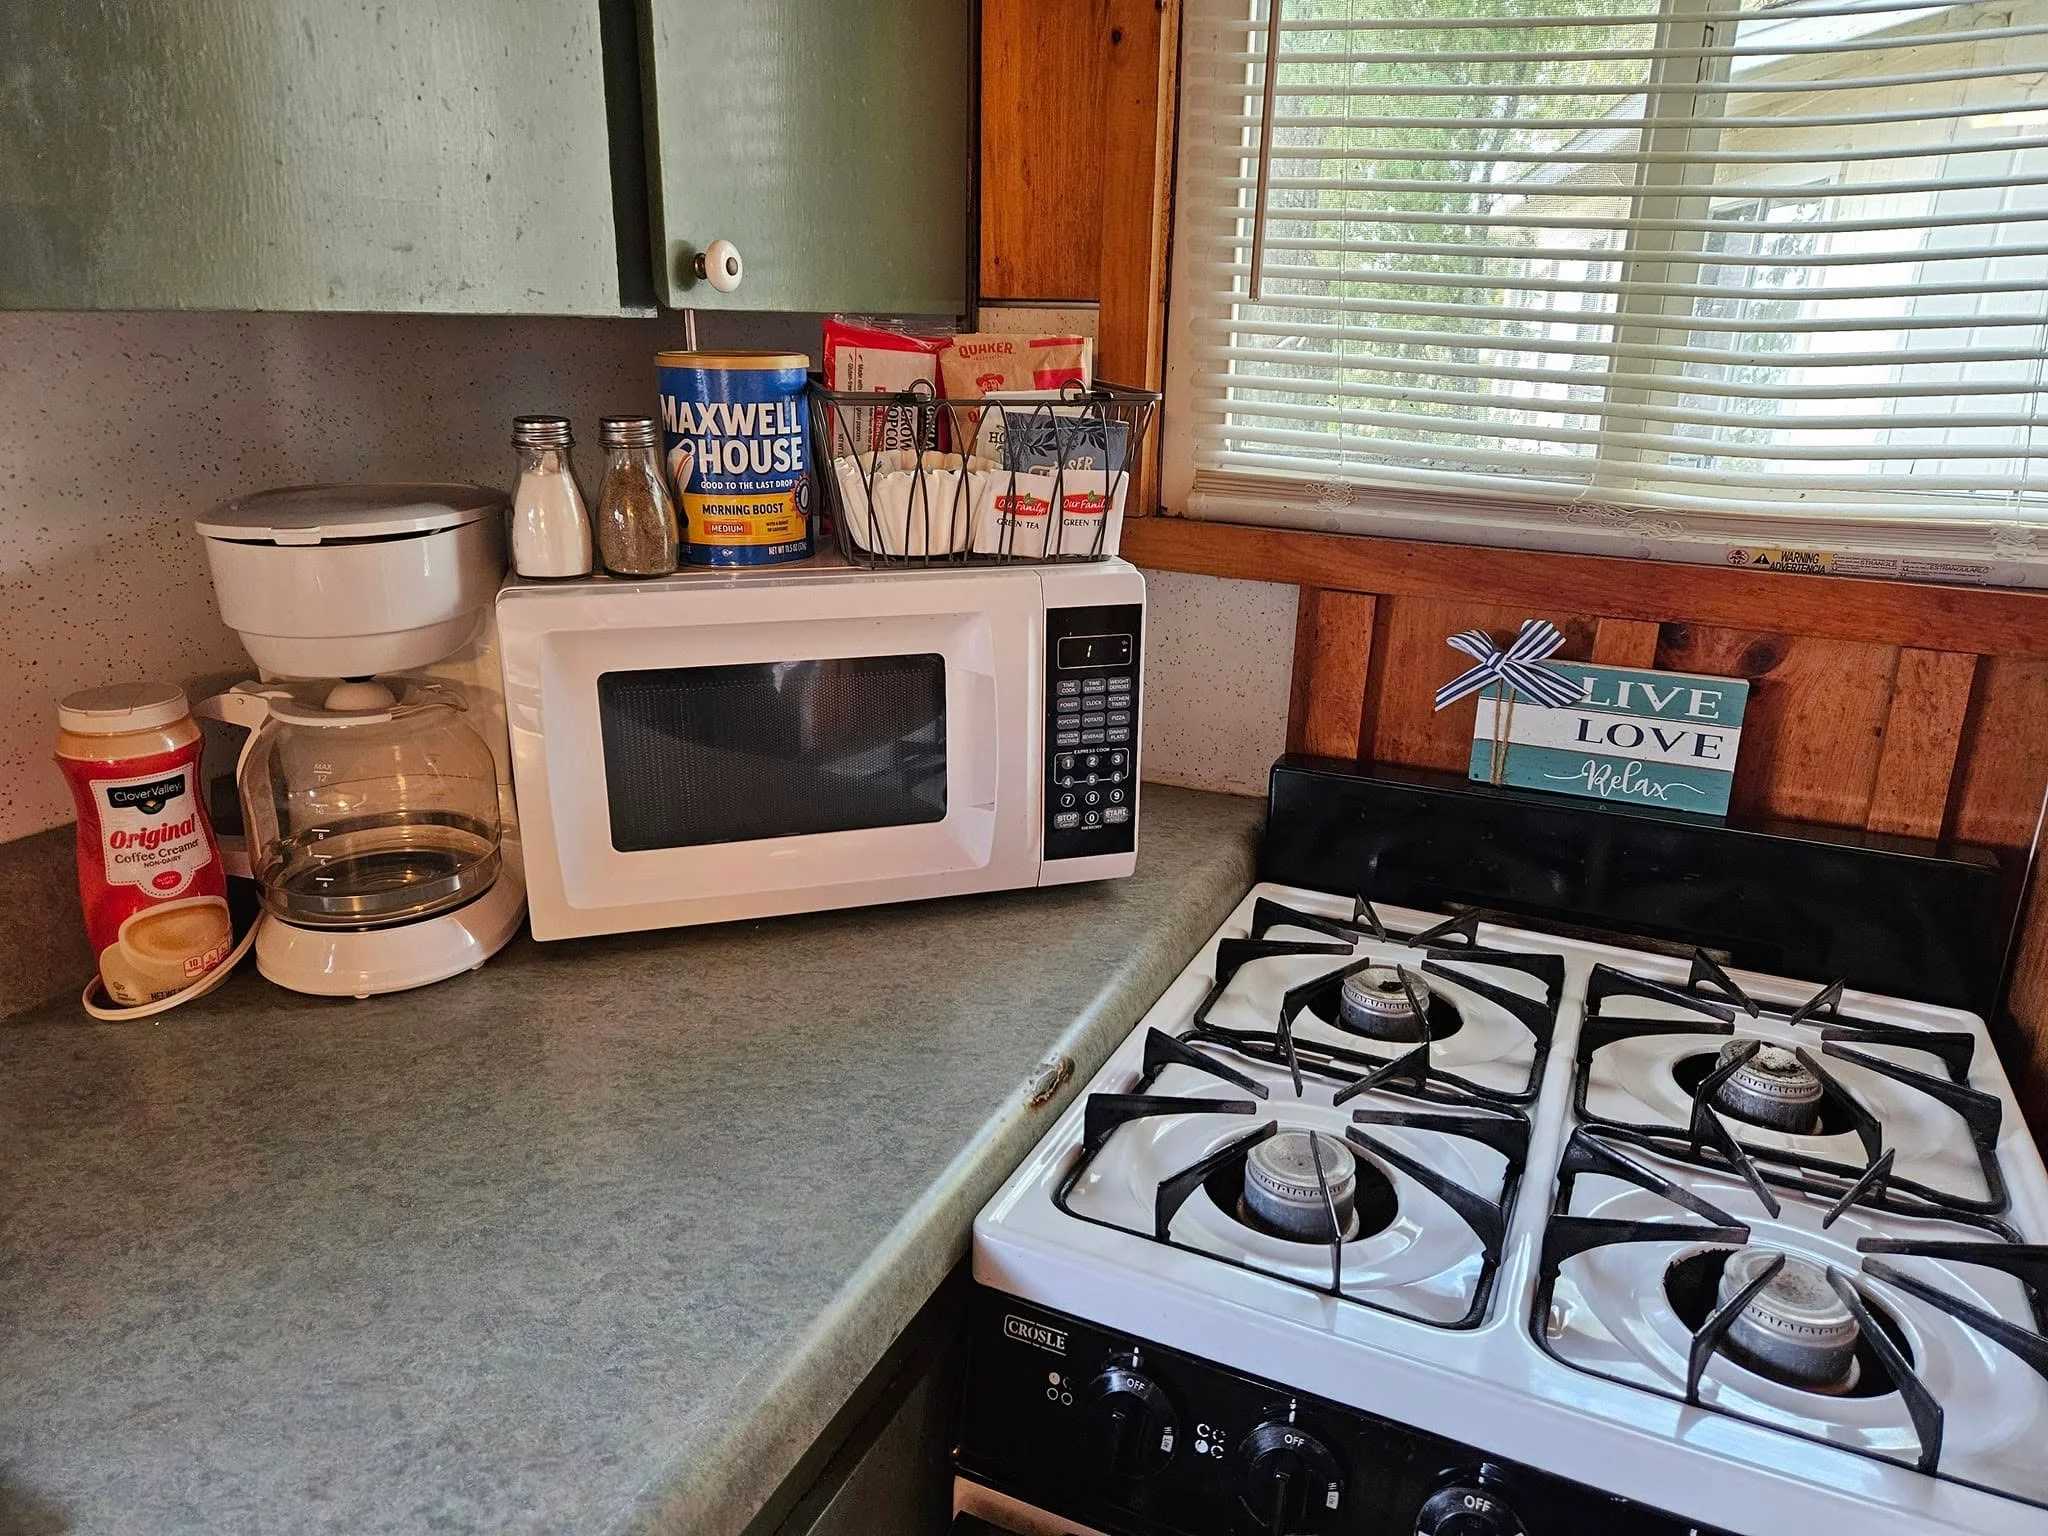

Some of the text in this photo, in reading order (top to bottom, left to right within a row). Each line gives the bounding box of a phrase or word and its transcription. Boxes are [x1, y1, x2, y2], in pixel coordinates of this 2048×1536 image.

[959, 342, 1013, 358] QUAKER
[660, 394, 802, 436] MAXWELL
[699, 437, 803, 474] HOUSE
[701, 479, 793, 490] GOOD TO THE LAST DROP
[702, 503, 784, 515] MORNING BOOST
[1016, 500, 1045, 515] Family
[1063, 499, 1107, 509] Our Famil
[1026, 521, 1040, 530] TEA
[1063, 518, 1089, 527] GREEN
[711, 524, 744, 534] MEDIUM
[768, 546, 777, 555] NET
[1781, 551, 1820, 564] WARNING
[1769, 561, 1826, 576] ADVERTENCIA
[1581, 676, 1724, 720] LIVE
[1575, 717, 1724, 760] LOVE
[1089, 757, 1096, 765] 2
[1114, 754, 1121, 763] 3
[1064, 777, 1071, 786] 4
[1089, 775, 1096, 783] 5
[1114, 773, 1121, 782] 6
[1543, 759, 1706, 800] Relax
[114, 789, 150, 802] Clover
[1065, 796, 1071, 804] 7
[1089, 793, 1096, 802] 8
[1114, 791, 1121, 800] 9
[1057, 813, 1077, 821] STOP
[1089, 813, 1095, 822] 0
[110, 813, 195, 850] Original
[115, 839, 199, 864] Coffee Creamer
[144, 855, 182, 868] NON-DAIRY
[1008, 1320, 1065, 1350] CROSLE
[1126, 1379, 1146, 1391] OFF
[1284, 1434, 1305, 1447] OFF
[1464, 1495, 1492, 1512] OFF
